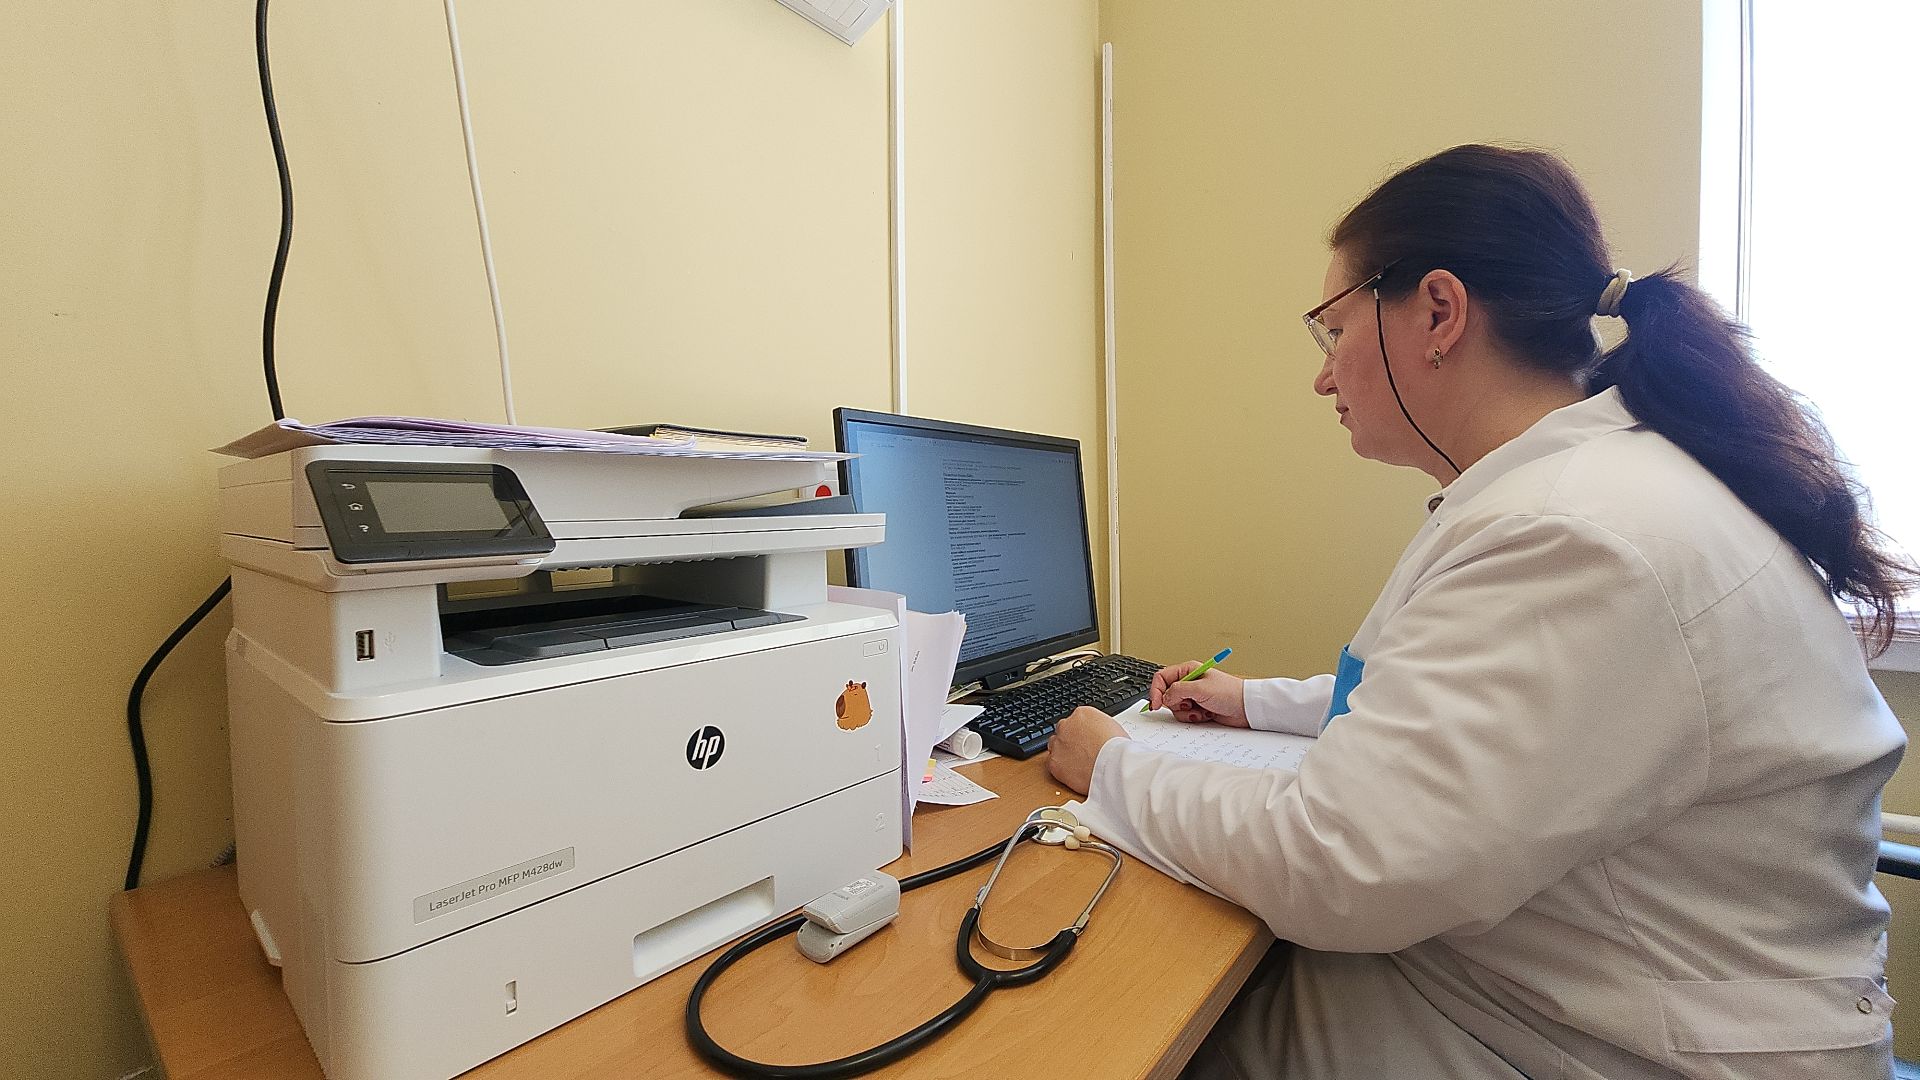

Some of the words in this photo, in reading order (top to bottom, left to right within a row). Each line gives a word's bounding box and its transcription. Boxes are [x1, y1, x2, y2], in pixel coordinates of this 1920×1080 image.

[689, 726, 722, 770] hp
[429, 888, 476, 912] LaserJet
[478, 883, 496, 895] Pro
[498, 873, 520, 888] MFP
[522, 859, 563, 880] M428dw
